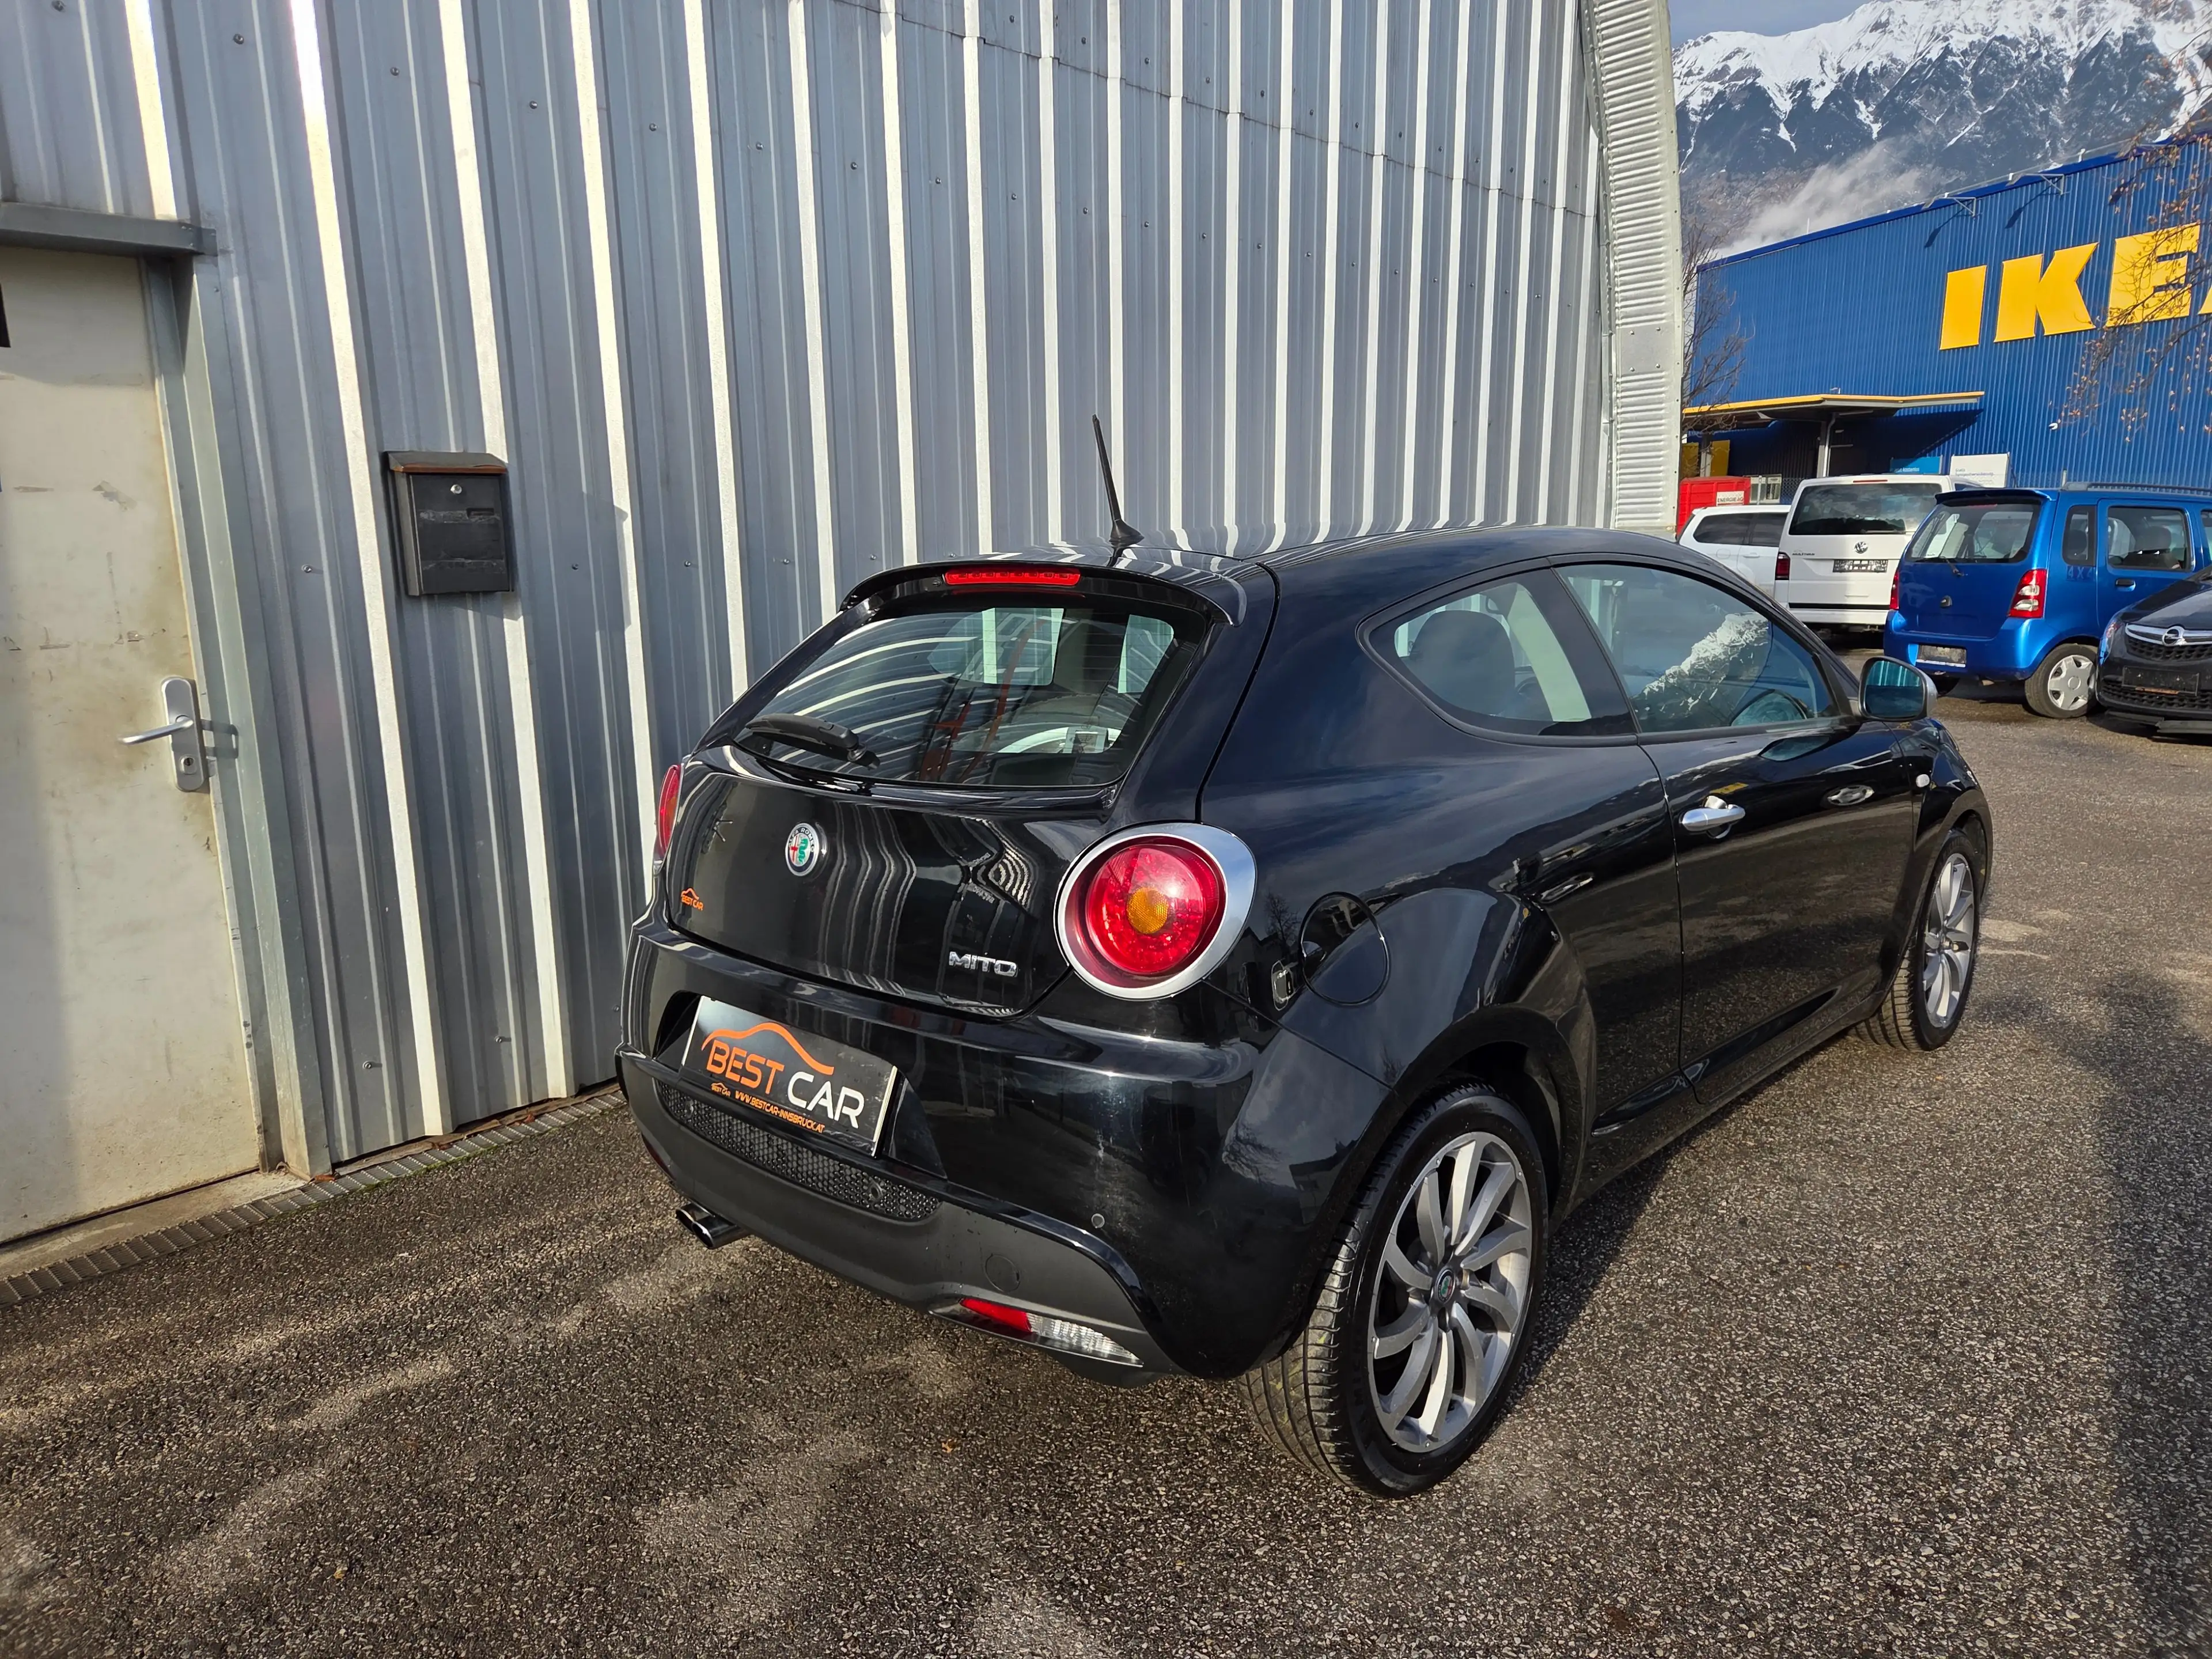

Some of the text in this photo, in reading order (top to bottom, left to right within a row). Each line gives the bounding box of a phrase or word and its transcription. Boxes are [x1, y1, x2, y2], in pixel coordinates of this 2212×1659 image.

[1940, 222, 2212, 350] IKE
[800, 828, 815, 853] ROMEO
[948, 951, 1018, 978] MITO
[706, 1039, 865, 1129] BEST CAR
